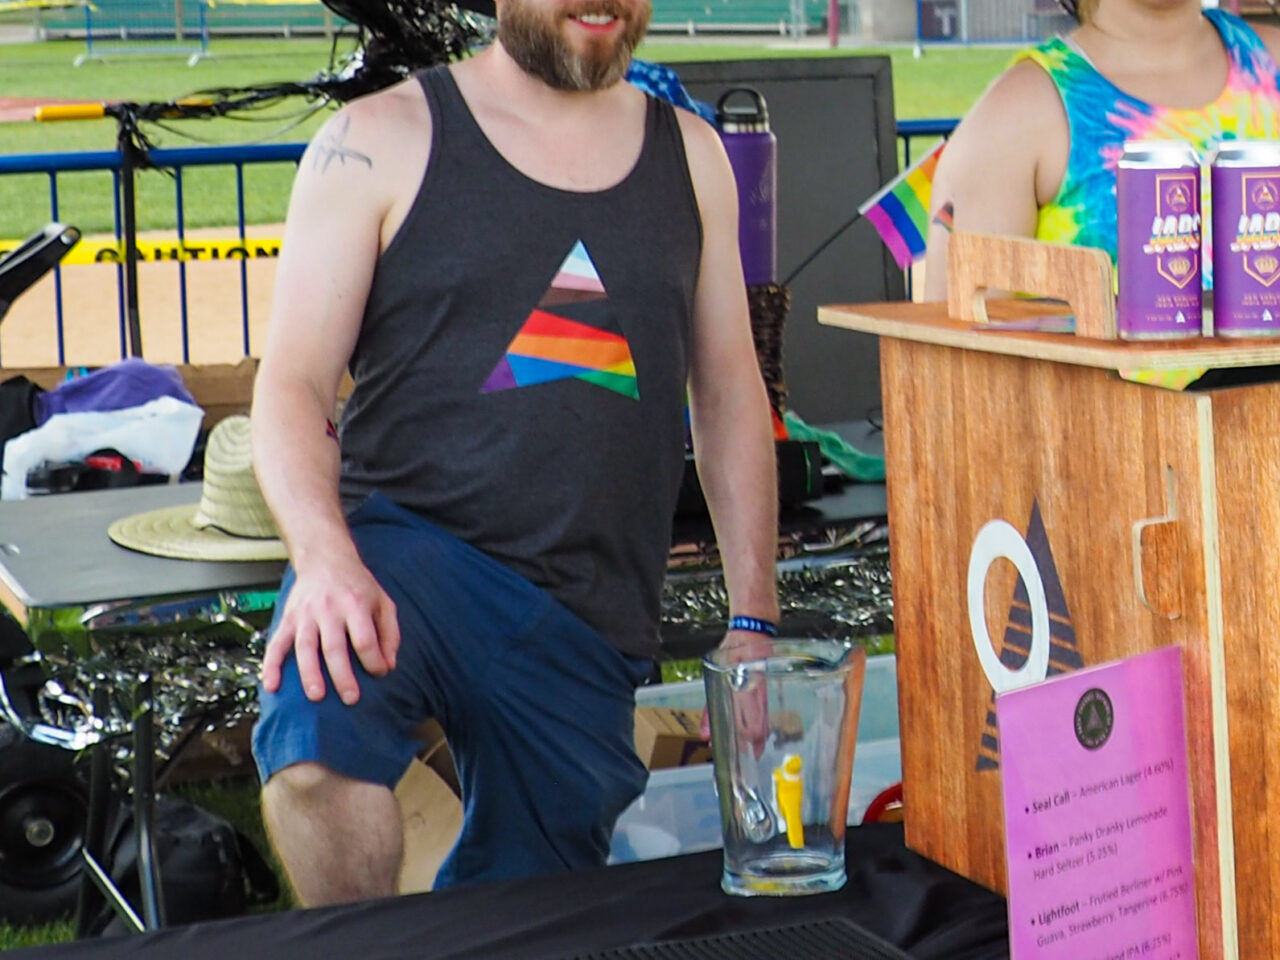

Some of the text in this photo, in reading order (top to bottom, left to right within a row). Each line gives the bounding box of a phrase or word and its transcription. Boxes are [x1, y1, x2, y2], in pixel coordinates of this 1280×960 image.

[1032, 796, 1051, 814] Seal
[1053, 790, 1071, 807] Call
[1080, 778, 1120, 798] American
[1120, 771, 1142, 787] Lager
[1035, 843, 1060, 859] Brian
[1126, 806, 1168, 829] Lemonade
[1032, 863, 1055, 881] Hard
[1056, 854, 1084, 873] Seltzer
[1038, 901, 1080, 926] Lightfoot
[1120, 875, 1152, 896] Berliner
[1117, 896, 1157, 917] Tangerine
